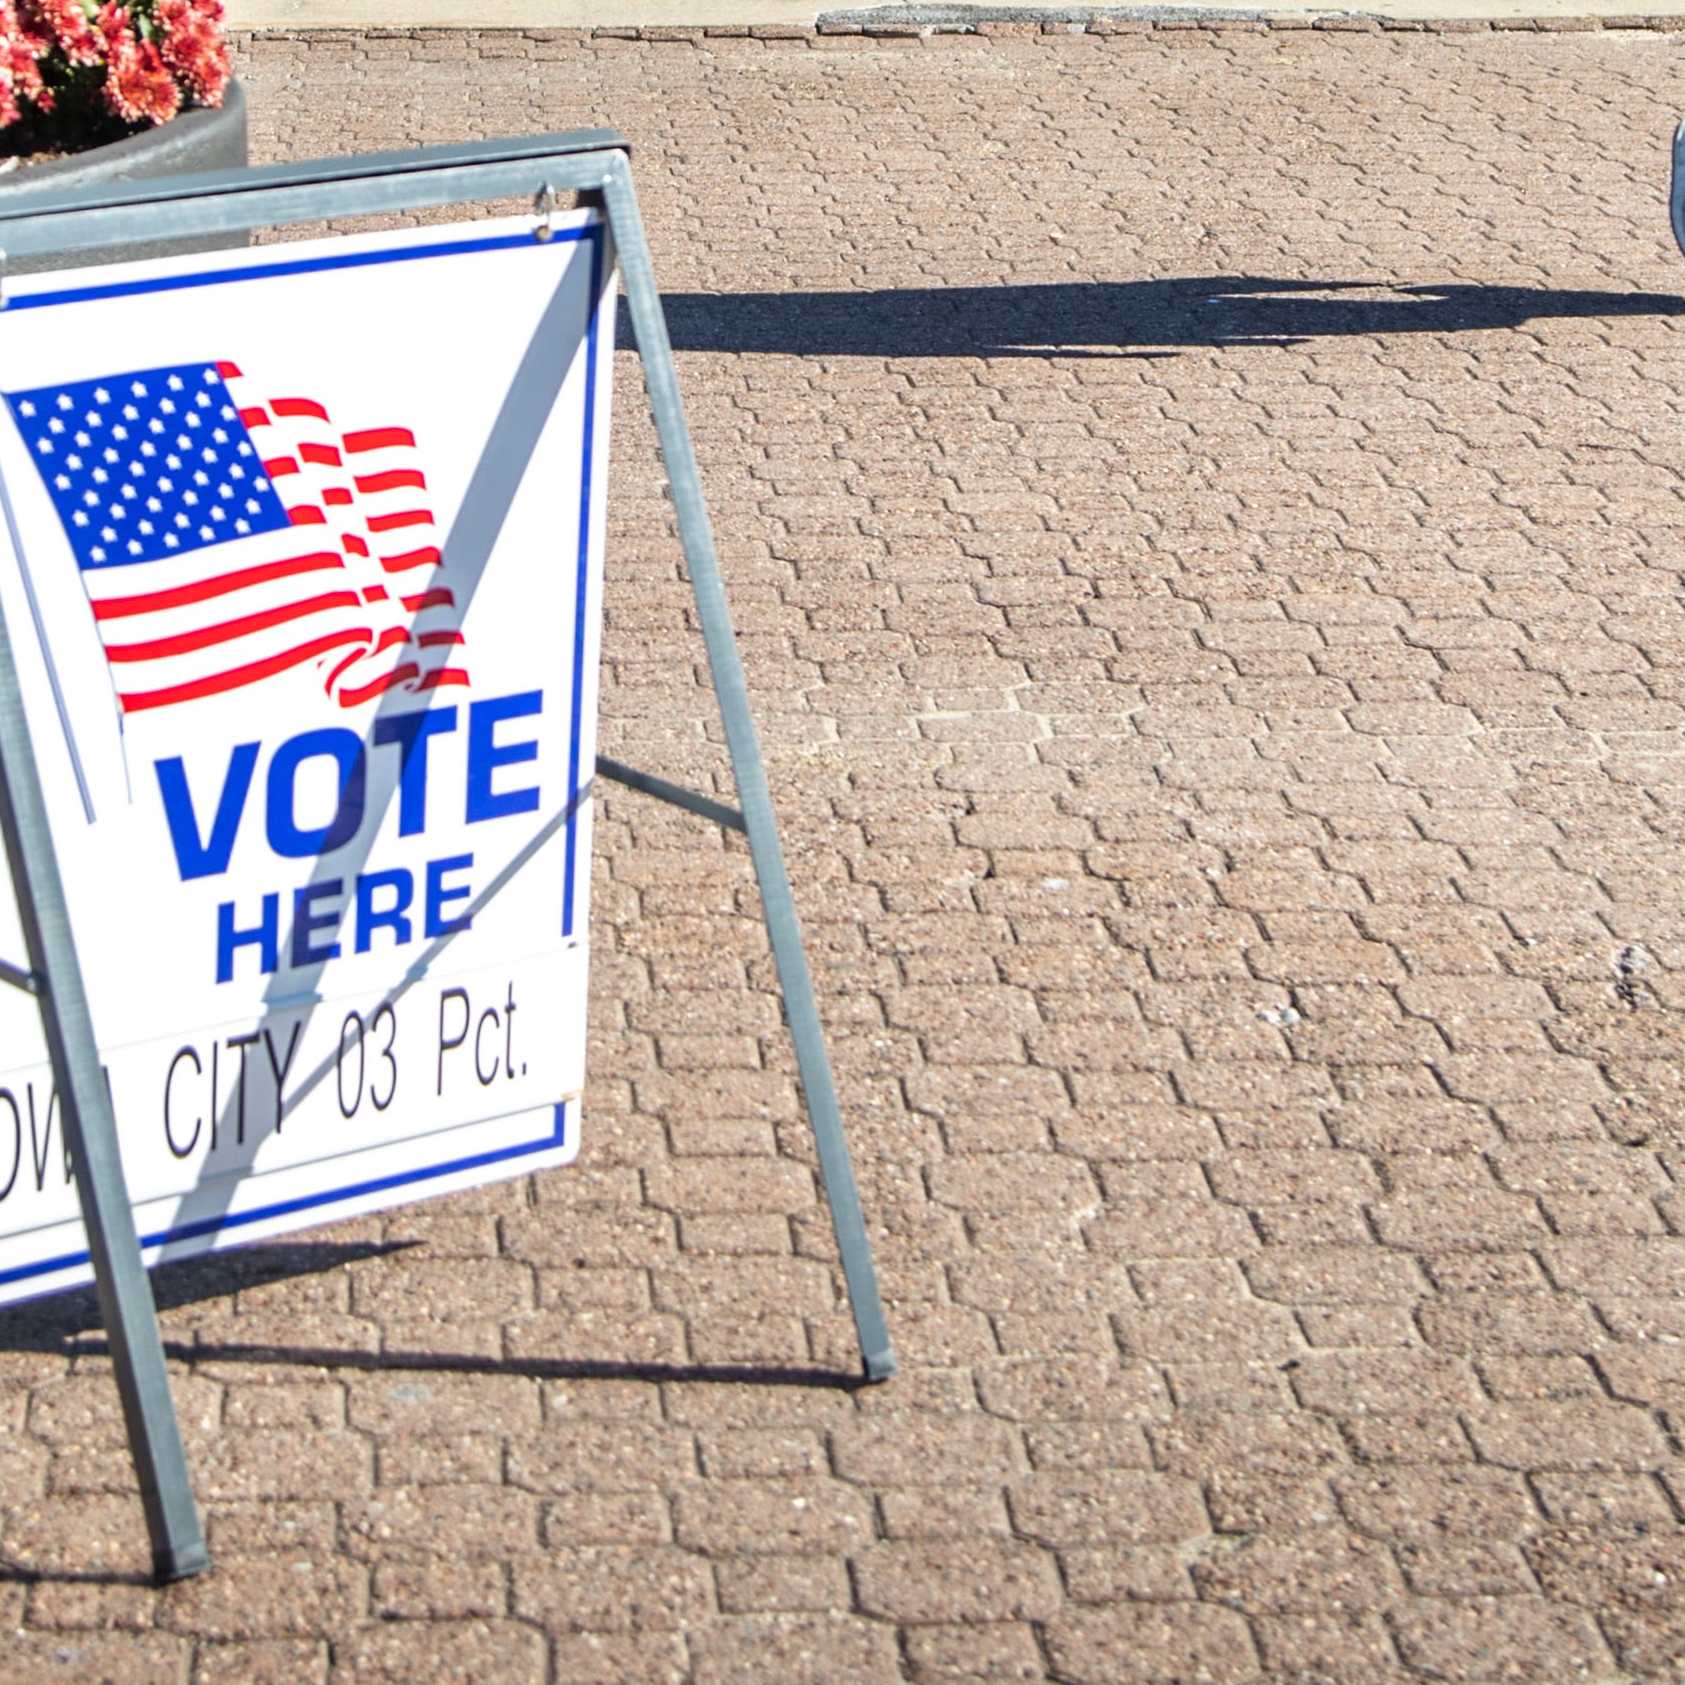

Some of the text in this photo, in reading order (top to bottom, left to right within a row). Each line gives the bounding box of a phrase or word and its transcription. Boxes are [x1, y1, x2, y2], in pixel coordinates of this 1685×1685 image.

[154, 689, 544, 882] VOTE
[216, 853, 475, 983] HERE
[164, 1019, 301, 1160] CITY
[337, 1001, 397, 1119] 03
[437, 980, 528, 1096] Pct.
